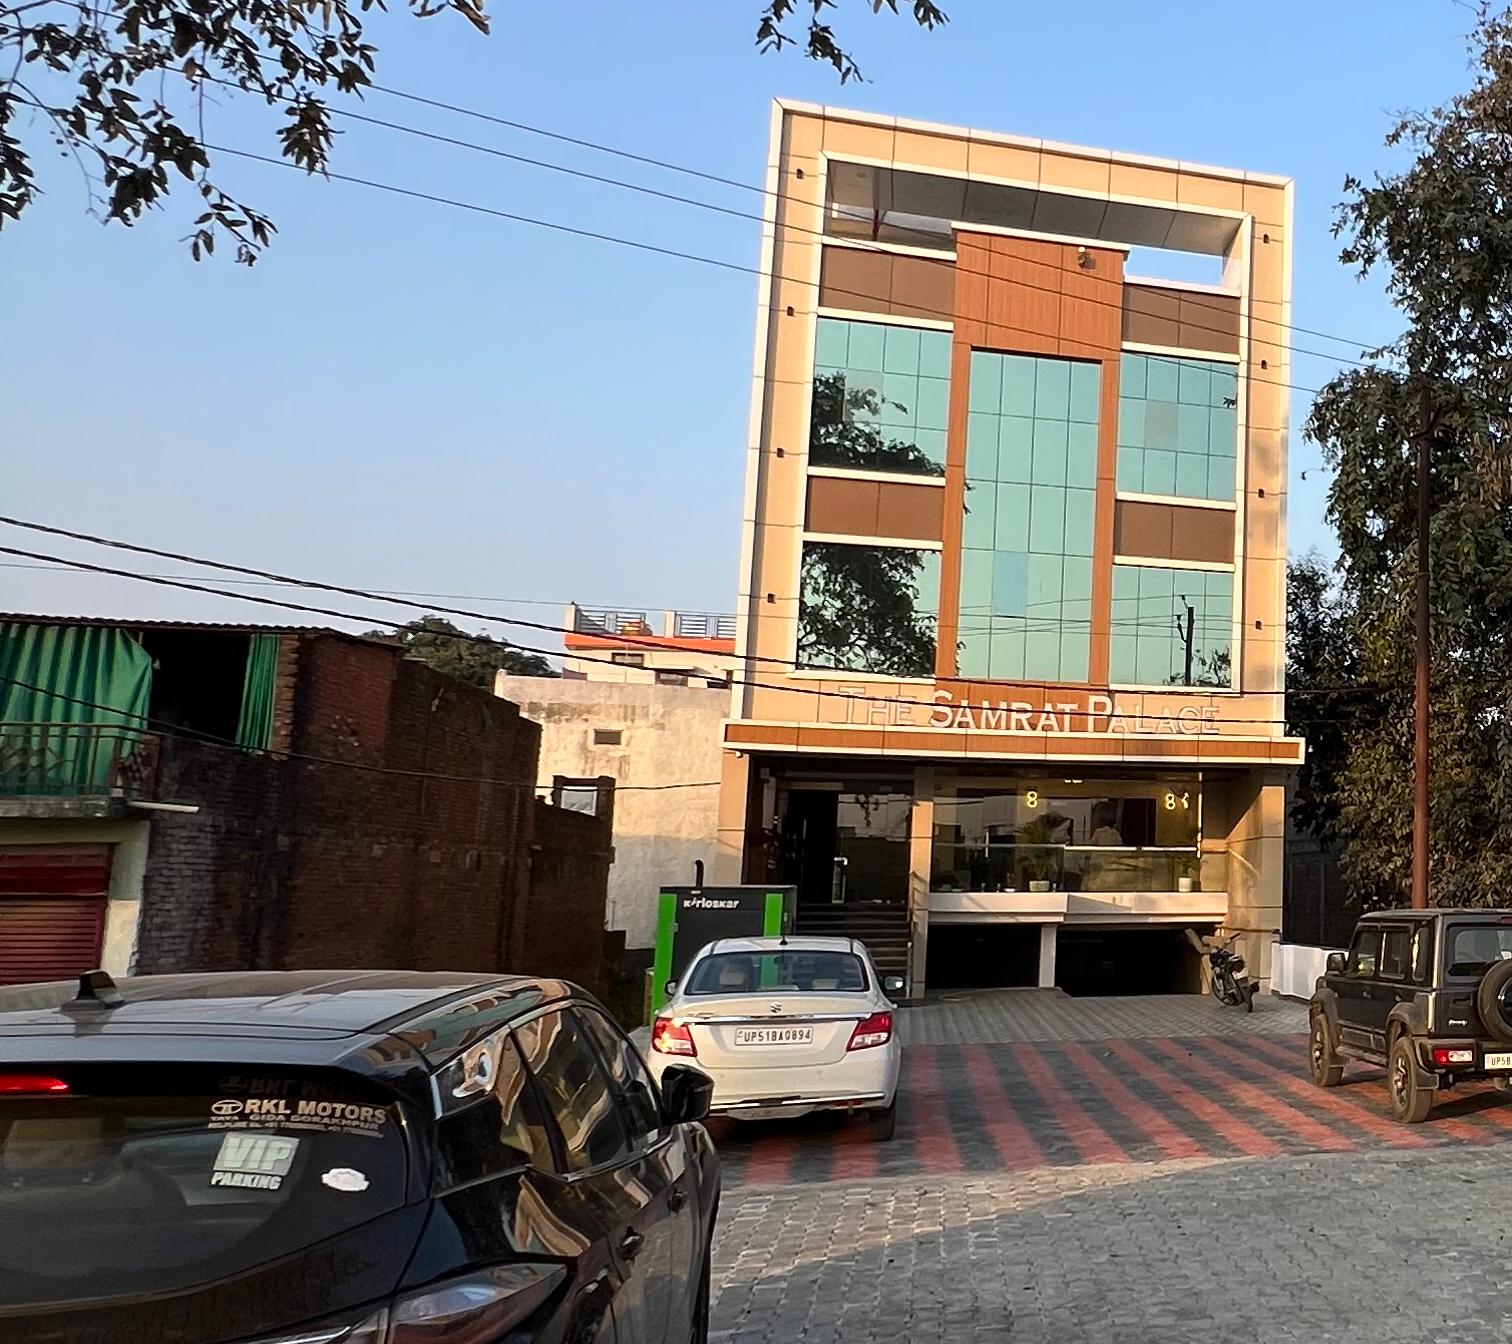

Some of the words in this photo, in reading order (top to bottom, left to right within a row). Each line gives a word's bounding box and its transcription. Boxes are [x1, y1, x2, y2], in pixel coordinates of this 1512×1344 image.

[839, 686, 917, 726] THE
[929, 689, 1079, 732] SAMRAT
[1088, 694, 1220, 735] PALACE
[244, 1099, 291, 1114] RKL
[298, 1100, 387, 1124] MOTORS
[223, 1137, 293, 1170] VIP
[211, 1172, 283, 1190] PARKING
